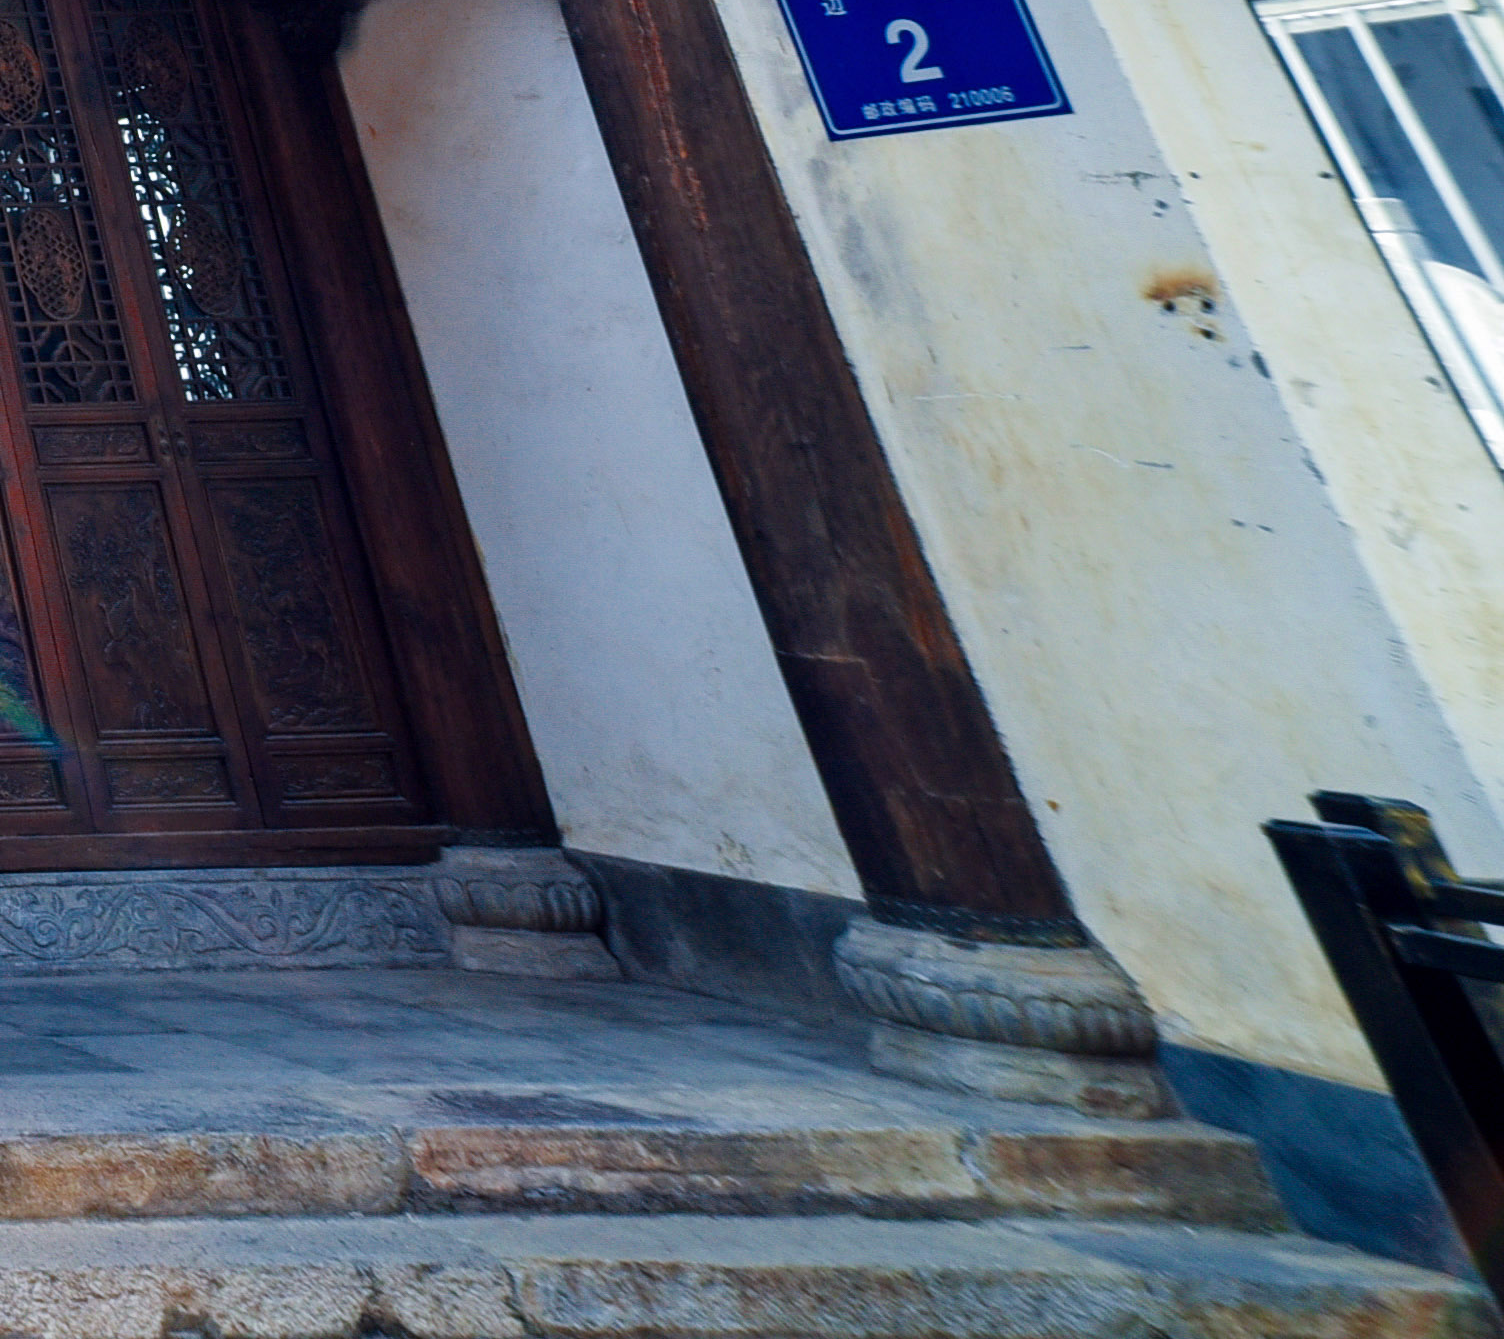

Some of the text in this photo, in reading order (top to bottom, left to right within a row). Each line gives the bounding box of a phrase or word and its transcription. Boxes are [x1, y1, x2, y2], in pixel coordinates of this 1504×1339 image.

[884, 18, 945, 84] 2
[860, 95, 938, 120] 邮政编码
